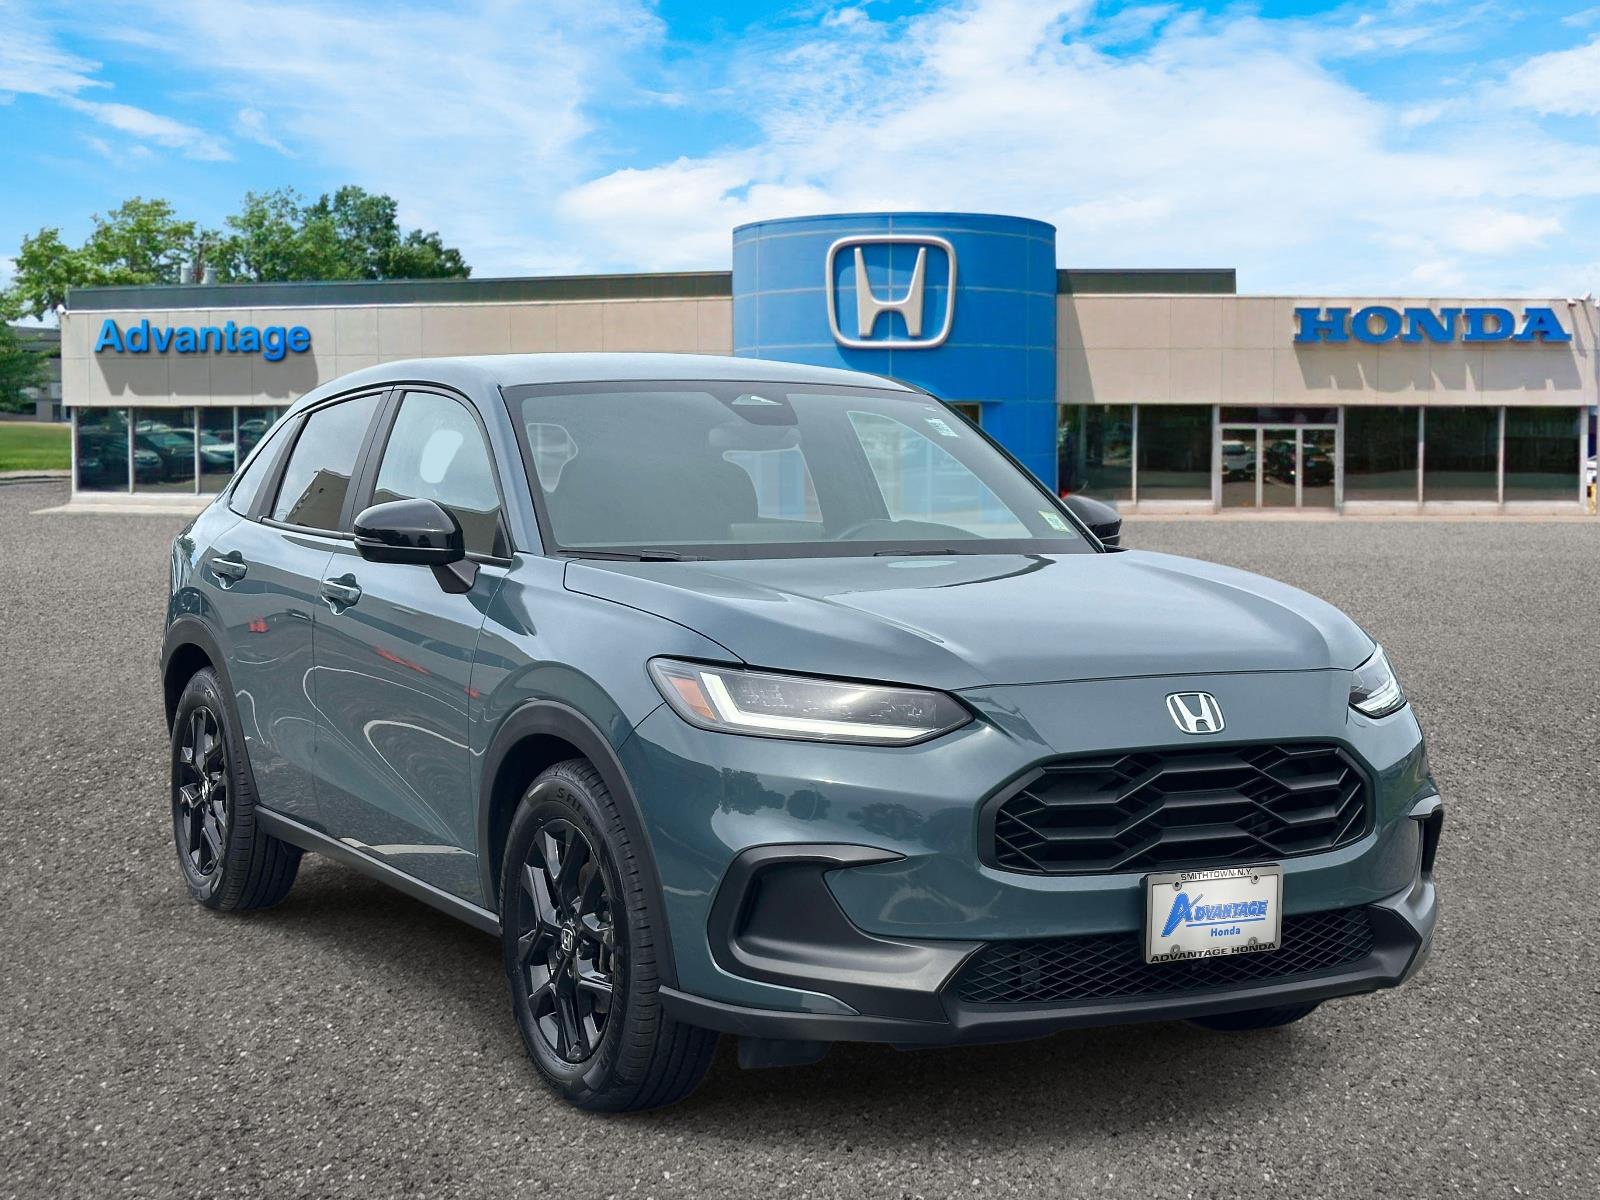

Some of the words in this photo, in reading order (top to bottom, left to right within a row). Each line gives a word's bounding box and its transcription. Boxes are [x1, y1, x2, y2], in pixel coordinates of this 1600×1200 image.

[94, 318, 312, 362] Advantage
[1294, 305, 1572, 344] HONDA
[1160, 891, 1269, 938] ADVANTAGE
[1210, 926, 1241, 937] Honda
[1150, 948, 1228, 963] ADVANTAGE
[1231, 942, 1276, 954] HONDA
